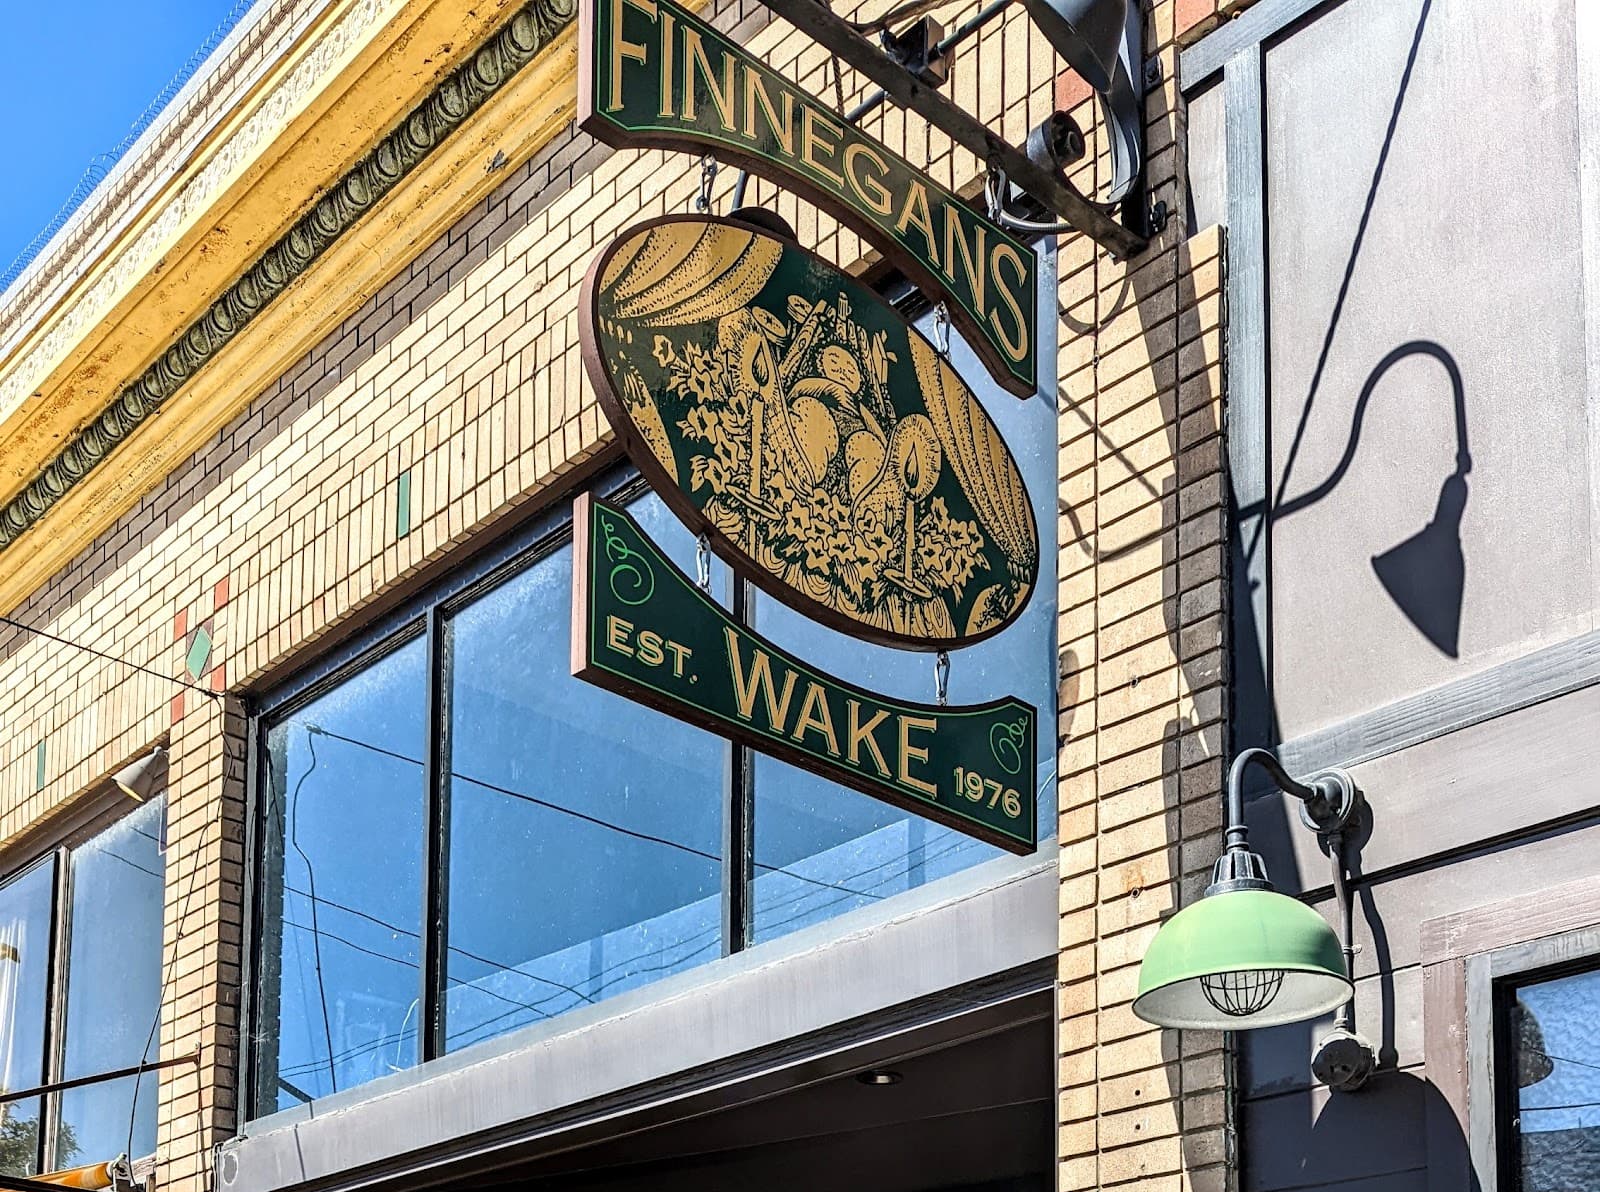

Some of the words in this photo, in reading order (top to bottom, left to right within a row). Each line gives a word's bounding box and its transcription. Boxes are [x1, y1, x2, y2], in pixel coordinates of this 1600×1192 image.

[607, 0, 1029, 363] FINNEGANS
[606, 615, 699, 684] EST.
[723, 625, 938, 800] WAKE
[954, 767, 1022, 818] 1976
